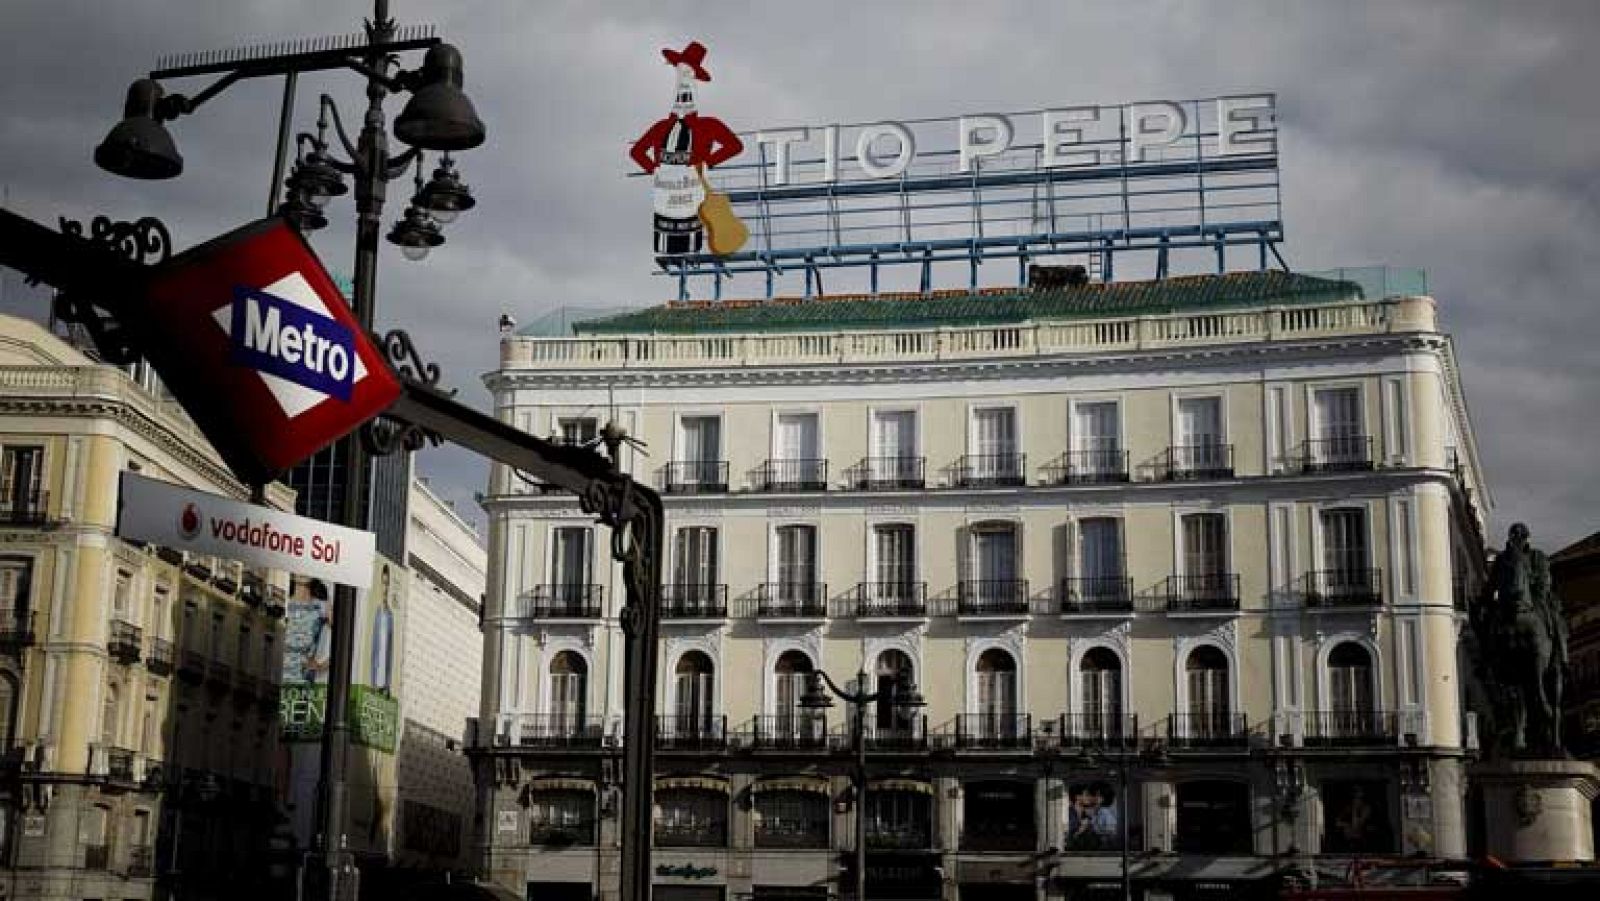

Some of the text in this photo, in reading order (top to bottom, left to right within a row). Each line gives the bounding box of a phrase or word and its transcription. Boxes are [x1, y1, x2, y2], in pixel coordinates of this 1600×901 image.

[757, 93, 1276, 185] TIO PEPE
[244, 297, 349, 381] Metro
[210, 516, 341, 564] vodafone Sol
